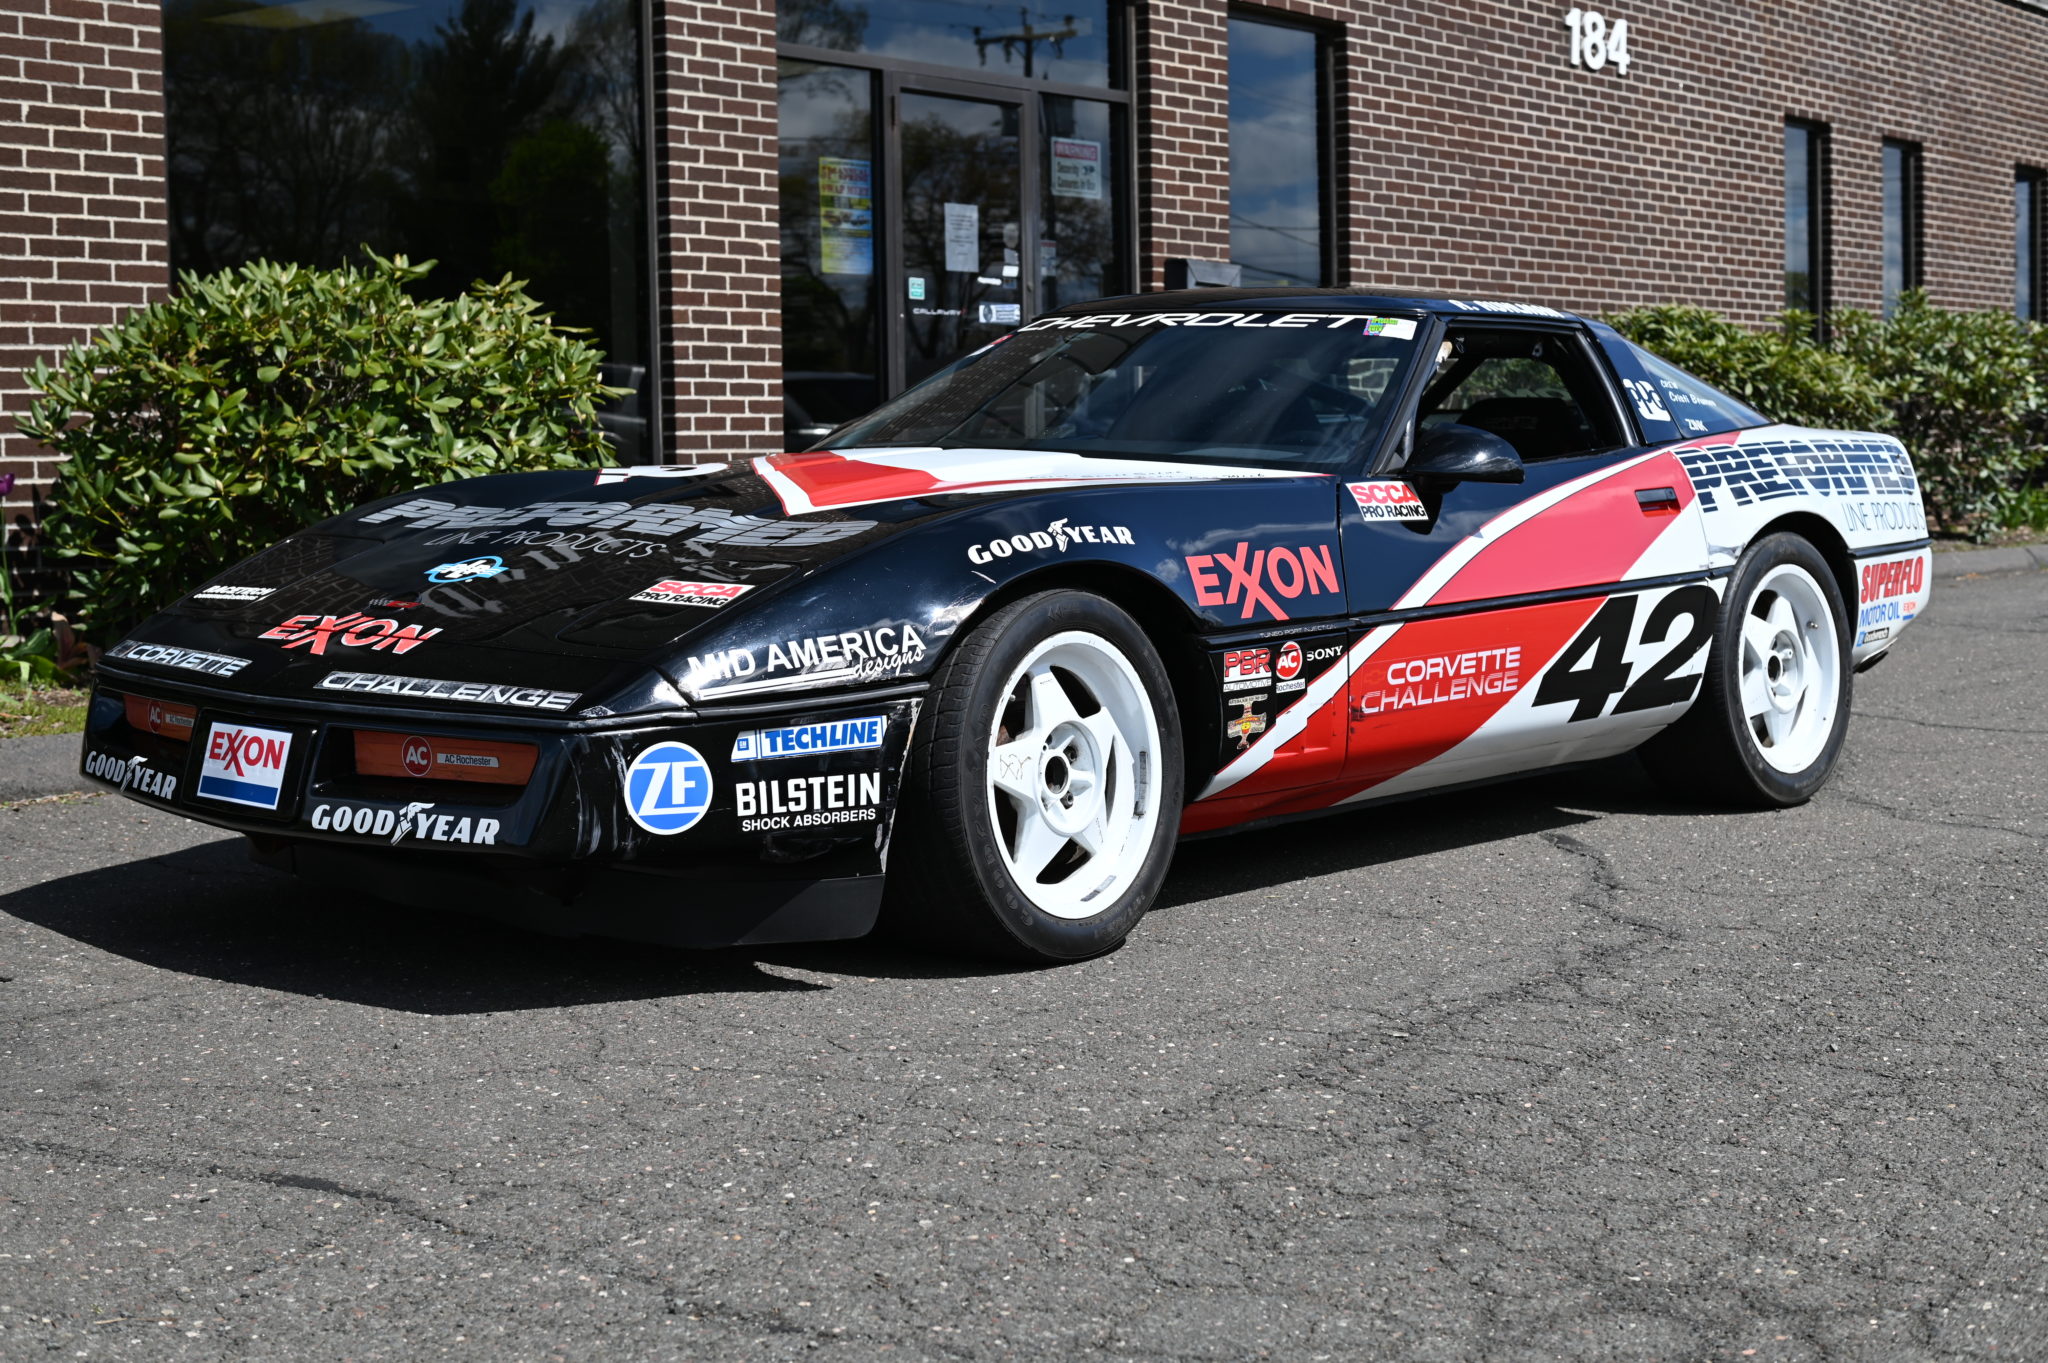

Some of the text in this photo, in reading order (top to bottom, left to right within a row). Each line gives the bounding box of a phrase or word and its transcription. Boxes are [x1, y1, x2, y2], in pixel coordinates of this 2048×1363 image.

[1565, 7, 1631, 75] 184
[1017, 313, 1379, 333] CHEVROLET
[1674, 439, 1917, 514] PREFORMED
[1350, 484, 1420, 505] SCCA
[358, 499, 878, 548] PREFORMED
[1360, 504, 1427, 518] PRO RACING
[1841, 501, 1927, 532] LINE PRODUCTS
[424, 531, 667, 558] LINE PRODUCTS
[649, 581, 744, 598] SCCA
[1185, 541, 1340, 621] EXXON
[1860, 556, 1923, 604] SUPERFLO
[634, 591, 729, 606] PRO RACING
[1859, 602, 1901, 627] MOTOR OIL
[258, 612, 444, 656] EXXON
[126, 645, 251, 677] CORVETTE
[688, 624, 927, 681] MID AMERICA
[853, 646, 925, 678] designs
[1225, 648, 1271, 677] PBR
[1277, 651, 1298, 669] AC
[1306, 645, 1343, 661] SONY
[1386, 646, 1522, 686] CORVETTE
[1531, 584, 1721, 723] 42
[322, 672, 580, 710] CHALLENGE
[1224, 679, 1271, 691] AUTOMOTIVE
[1361, 670, 1520, 713] CHALLENGE
[150, 706, 162, 723] AC
[765, 720, 879, 752] TECHLINE
[209, 729, 285, 777] EXXON
[405, 745, 428, 766] AC
[444, 753, 492, 766] AC Rochester
[637, 762, 703, 816] ZF
[735, 772, 881, 817] BILSTEIN
[742, 808, 876, 832] SHOCK ABSORBERS
